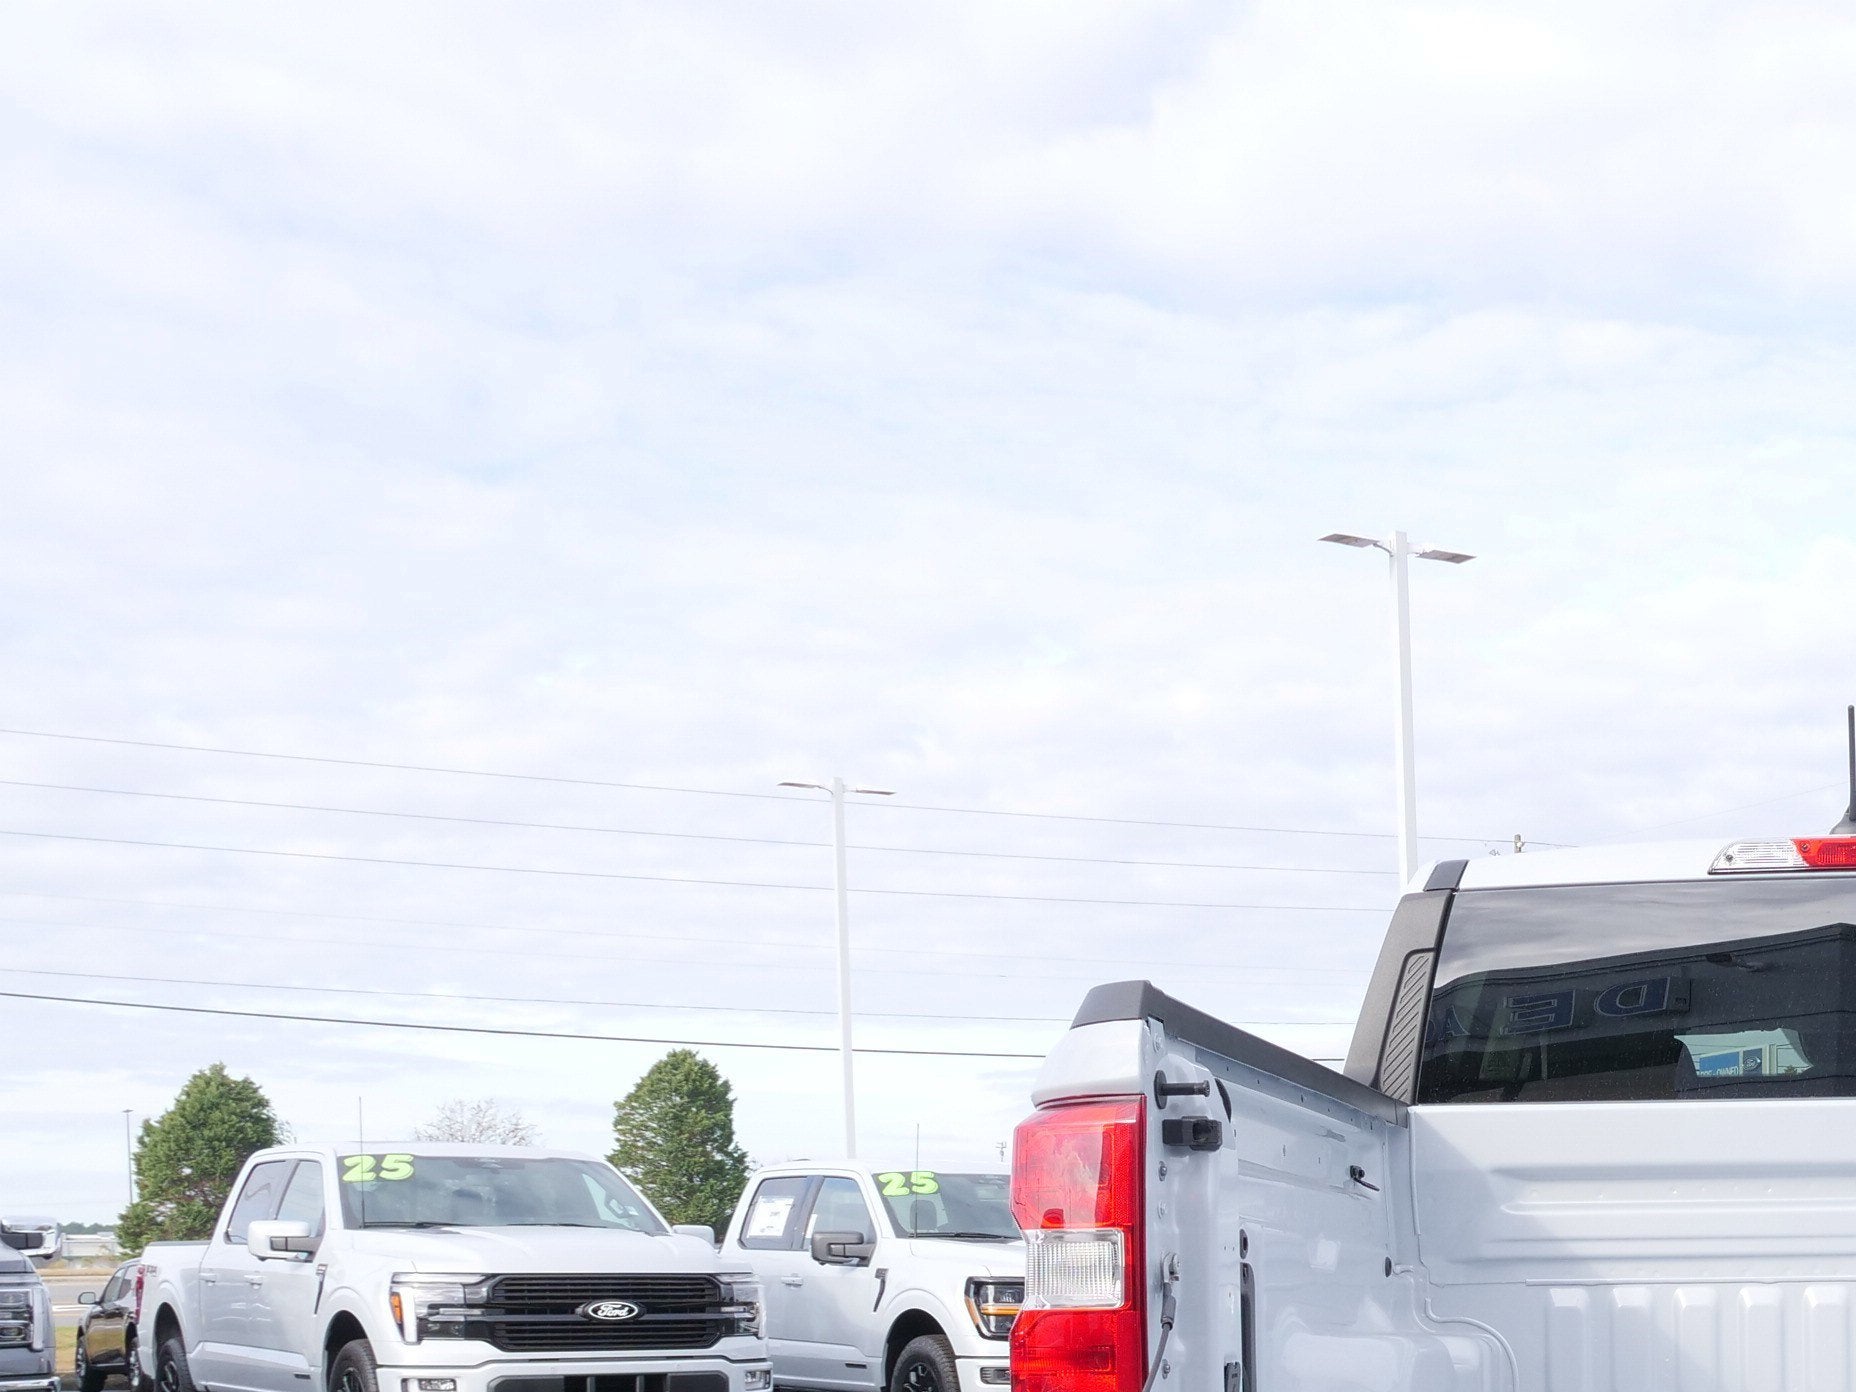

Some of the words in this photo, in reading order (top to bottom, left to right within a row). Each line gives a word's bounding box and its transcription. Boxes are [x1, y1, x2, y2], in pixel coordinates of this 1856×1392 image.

[342, 1153, 414, 1182] 25
[878, 1171, 939, 1196] 25
[597, 1303, 630, 1317] Ford
